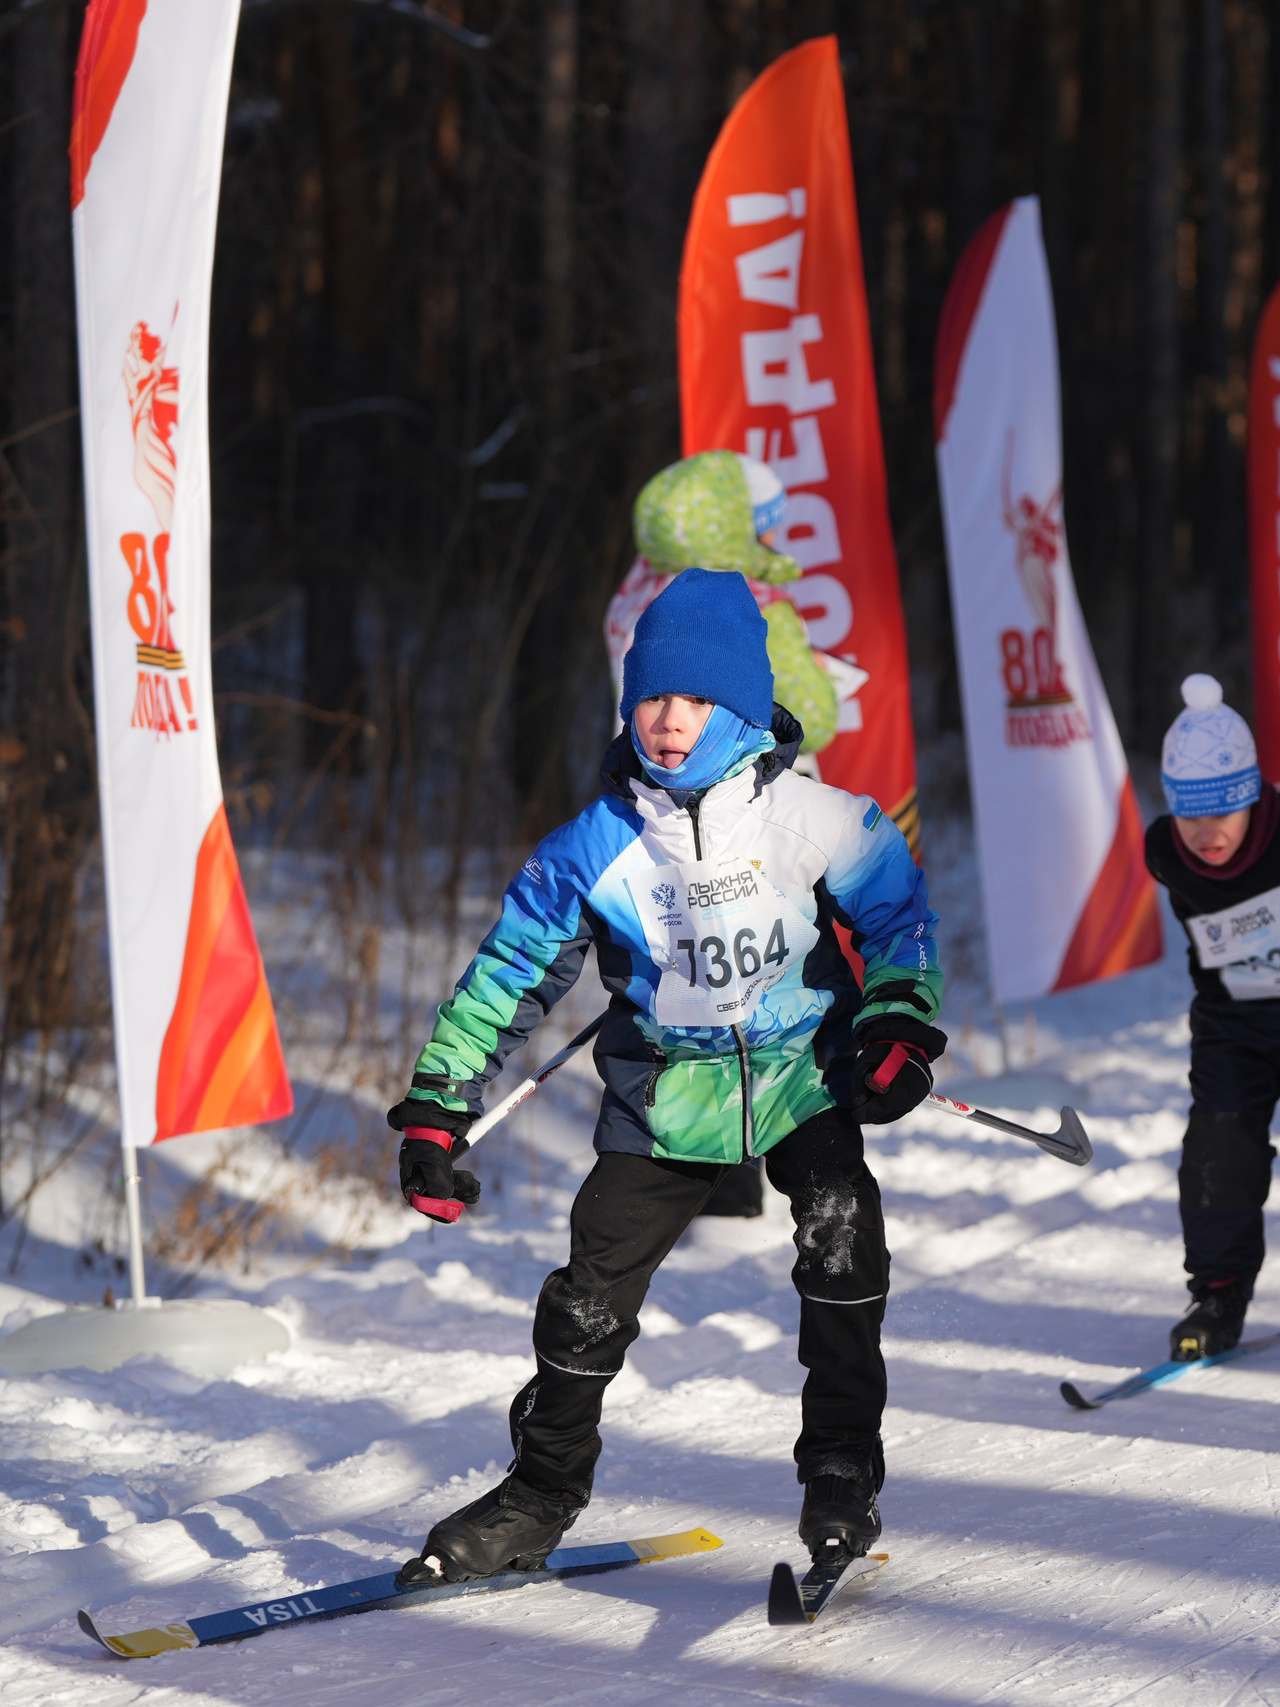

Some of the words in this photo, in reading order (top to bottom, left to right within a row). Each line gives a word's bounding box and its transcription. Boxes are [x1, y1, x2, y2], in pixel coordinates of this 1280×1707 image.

[1225, 777, 1258, 803] 2025
[687, 882, 759, 909] РОССИИ
[688, 870, 754, 896] ЛЫЖНЯ
[702, 899, 749, 921] 2025
[677, 918, 790, 988] 7364
[242, 1597, 325, 1626] TISA
